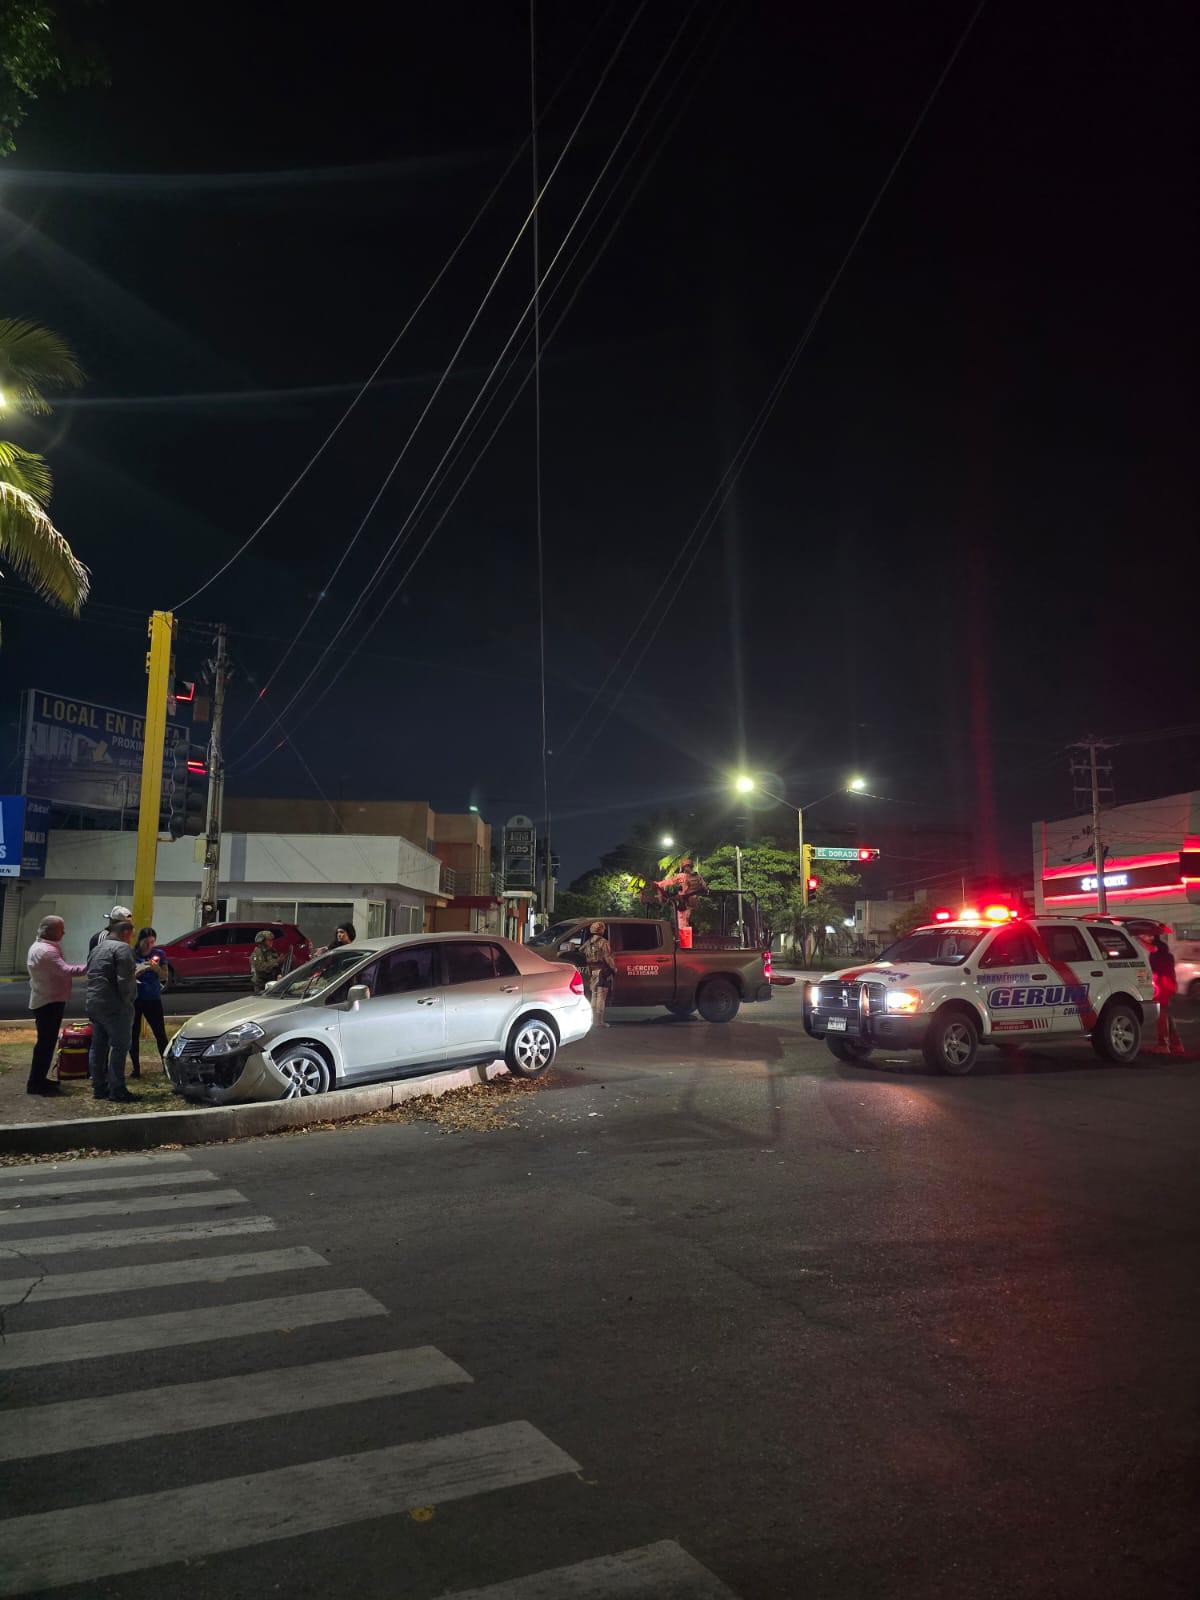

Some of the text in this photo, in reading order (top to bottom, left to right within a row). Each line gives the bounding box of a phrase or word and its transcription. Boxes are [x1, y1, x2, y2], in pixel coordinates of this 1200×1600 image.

[42, 697, 98, 729] LOCAL
[105, 713, 126, 735] EN
[817, 849, 858, 858] EL DORADO
[988, 985, 1090, 1008] GERUM
